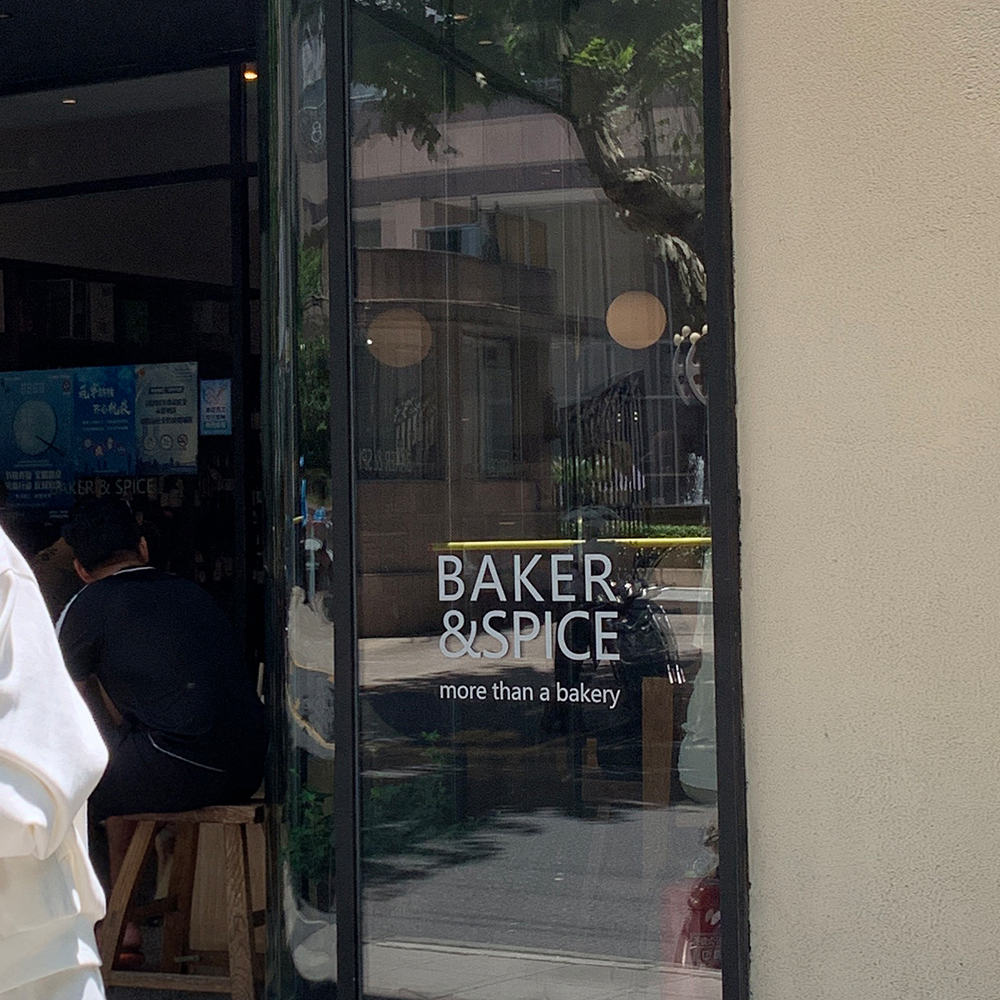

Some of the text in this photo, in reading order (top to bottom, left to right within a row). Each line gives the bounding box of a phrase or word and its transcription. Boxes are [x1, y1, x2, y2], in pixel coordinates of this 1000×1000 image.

[100, 479, 111, 495] &
[115, 478, 155, 495] SPICE
[437, 553, 616, 602] BAKER
[439, 609, 621, 661] &SPICE
[439, 681, 621, 709] more than a bakery
